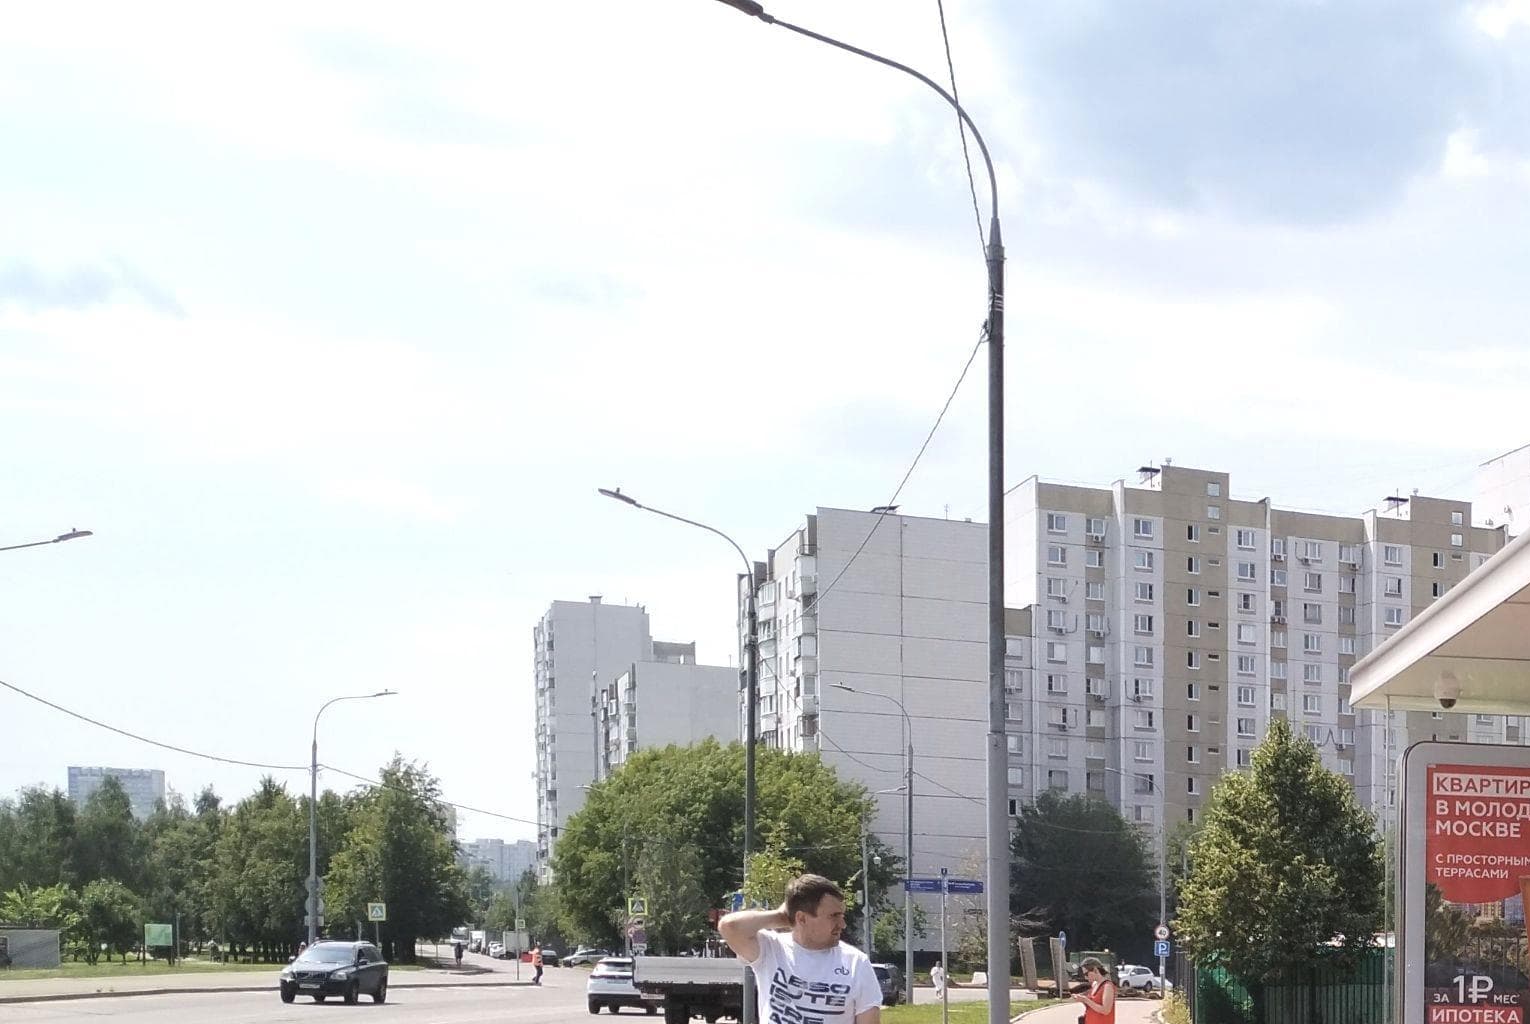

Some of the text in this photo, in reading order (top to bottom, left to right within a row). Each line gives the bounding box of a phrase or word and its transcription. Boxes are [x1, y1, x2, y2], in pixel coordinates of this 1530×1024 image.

[1436, 800, 1449, 816] В
[1435, 820, 1521, 838] МОСКВЕ
[1435, 854, 1444, 864] С
[1436, 867, 1509, 879] ТЕРРАСАМИ
[1433, 993, 1450, 1003] ЗА
[1432, 1008, 1521, 1024] ИПОТЕКА
